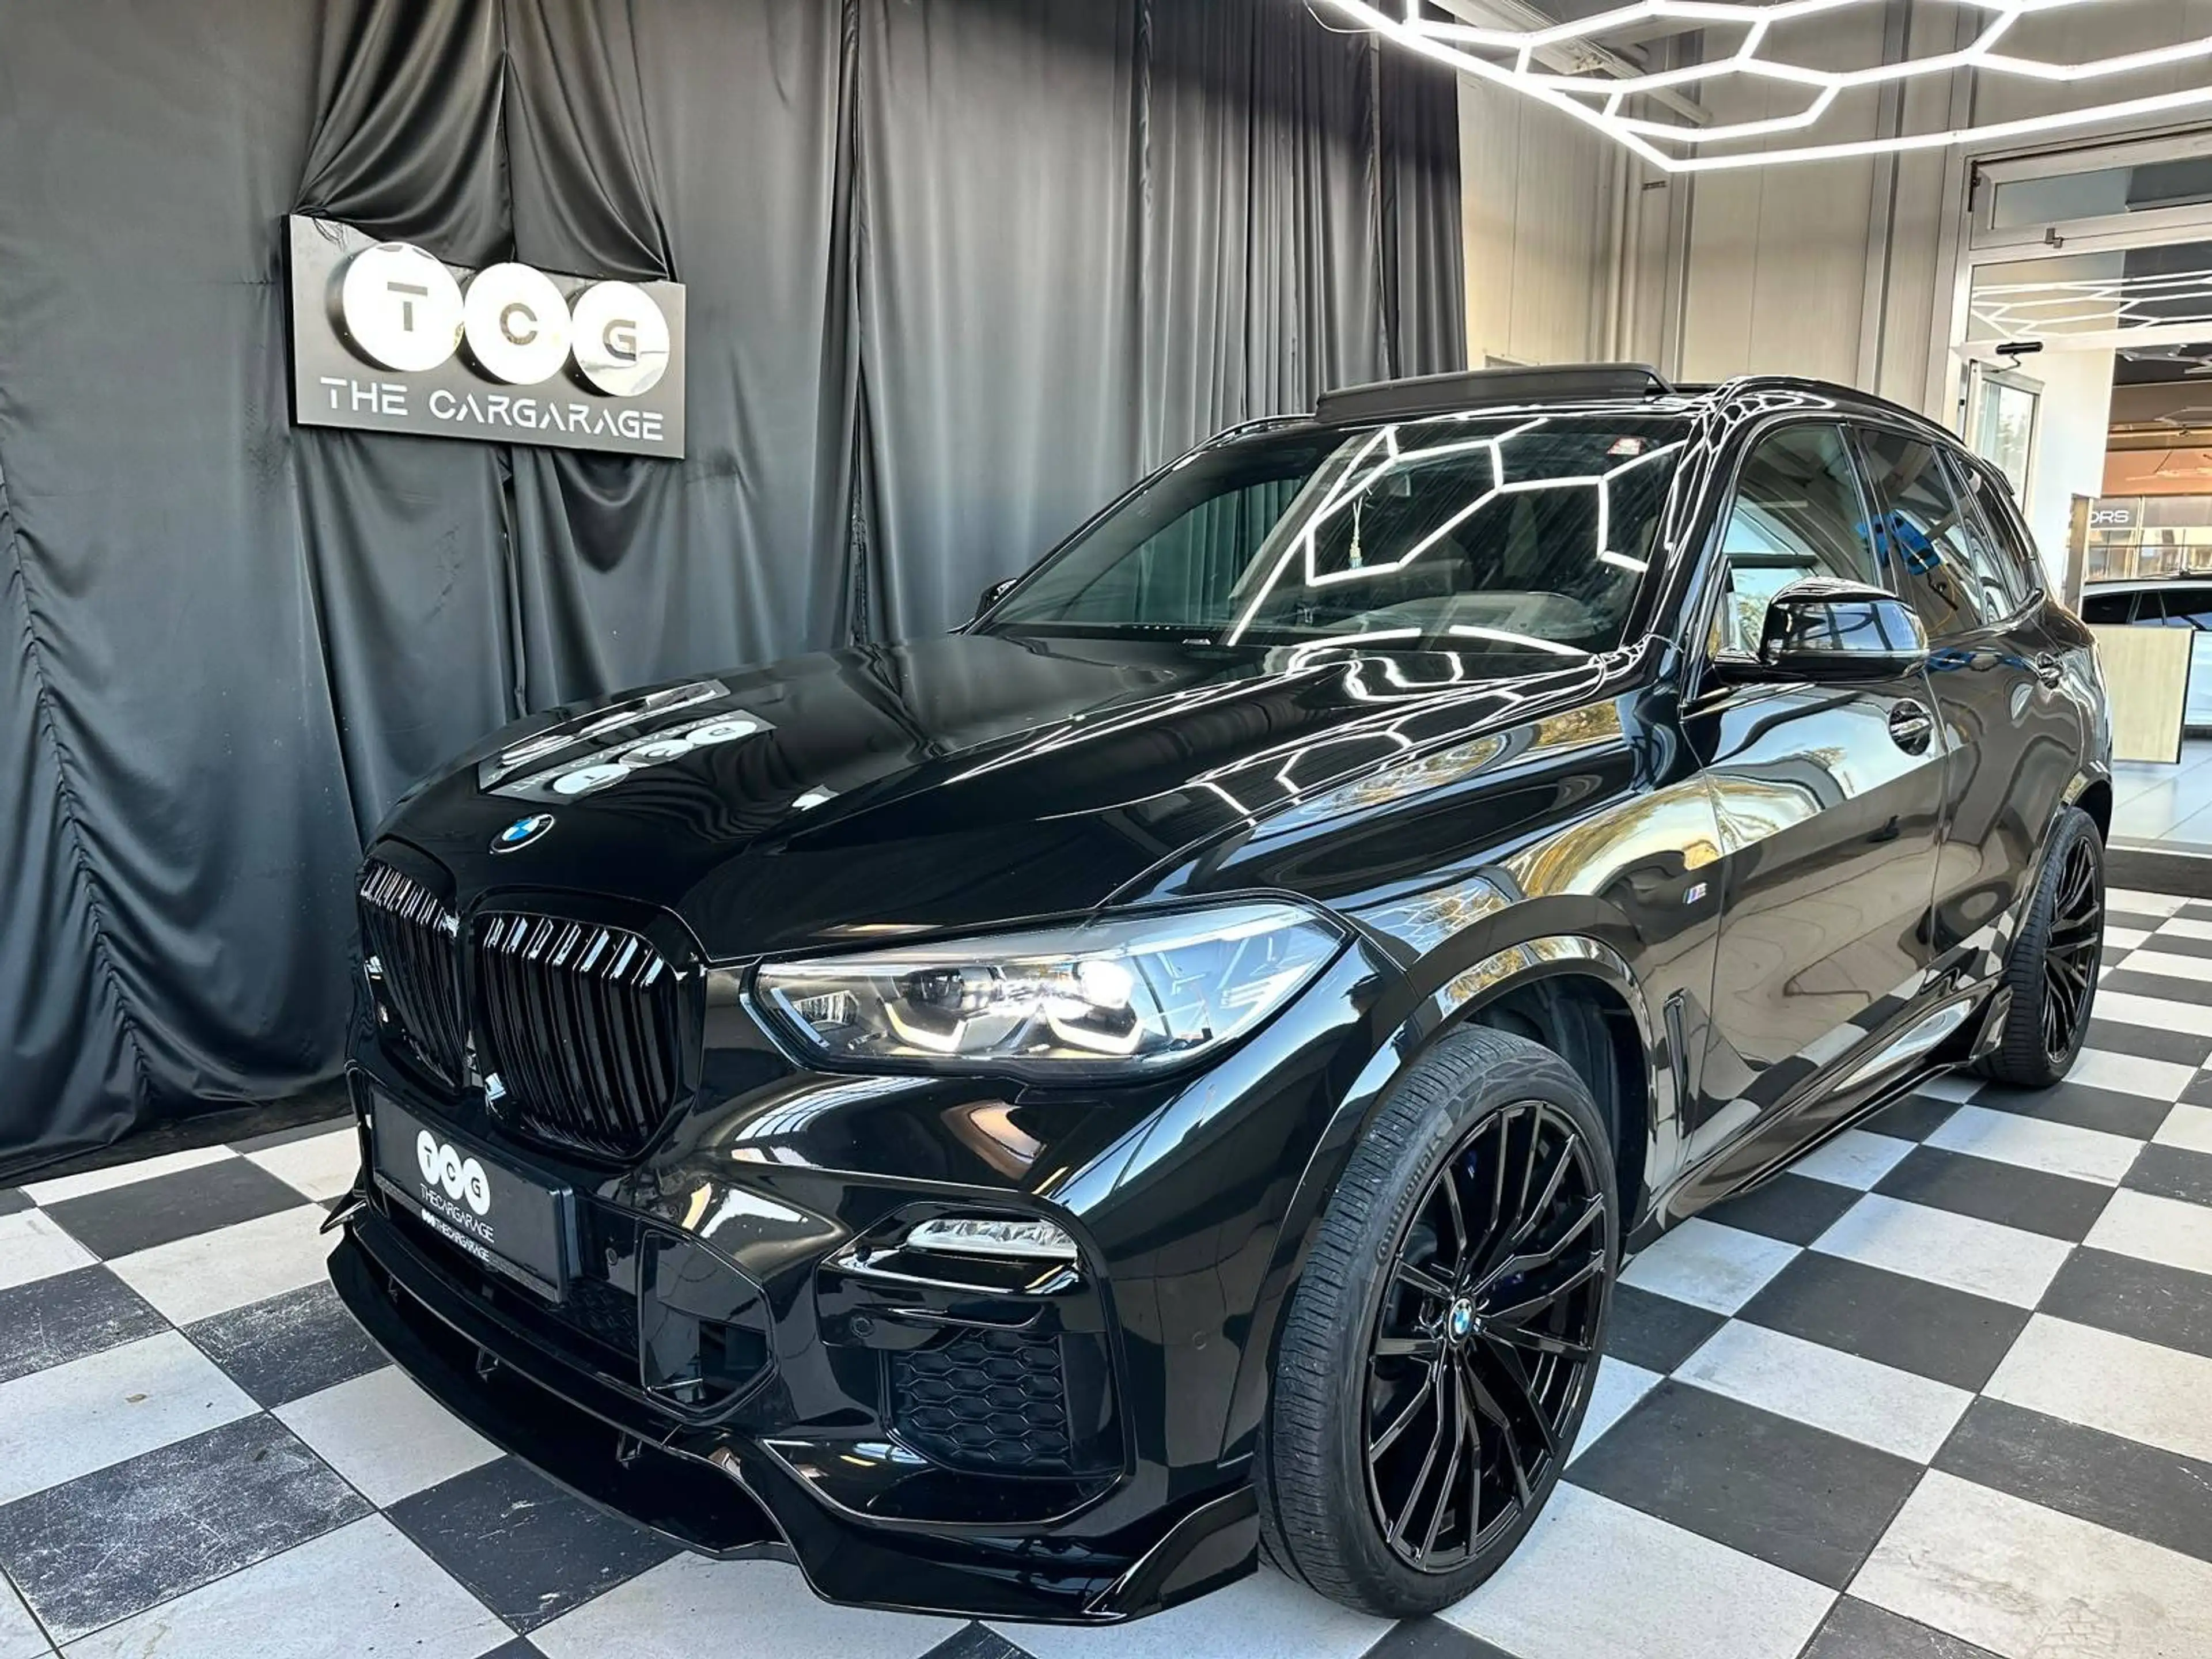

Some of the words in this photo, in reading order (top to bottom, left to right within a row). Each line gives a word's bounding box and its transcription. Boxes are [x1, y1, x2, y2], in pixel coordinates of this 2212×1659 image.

[320, 376, 408, 416] THE
[429, 389, 664, 441] CARGARAGE
[420, 1183, 494, 1244] THECARGARAGE
